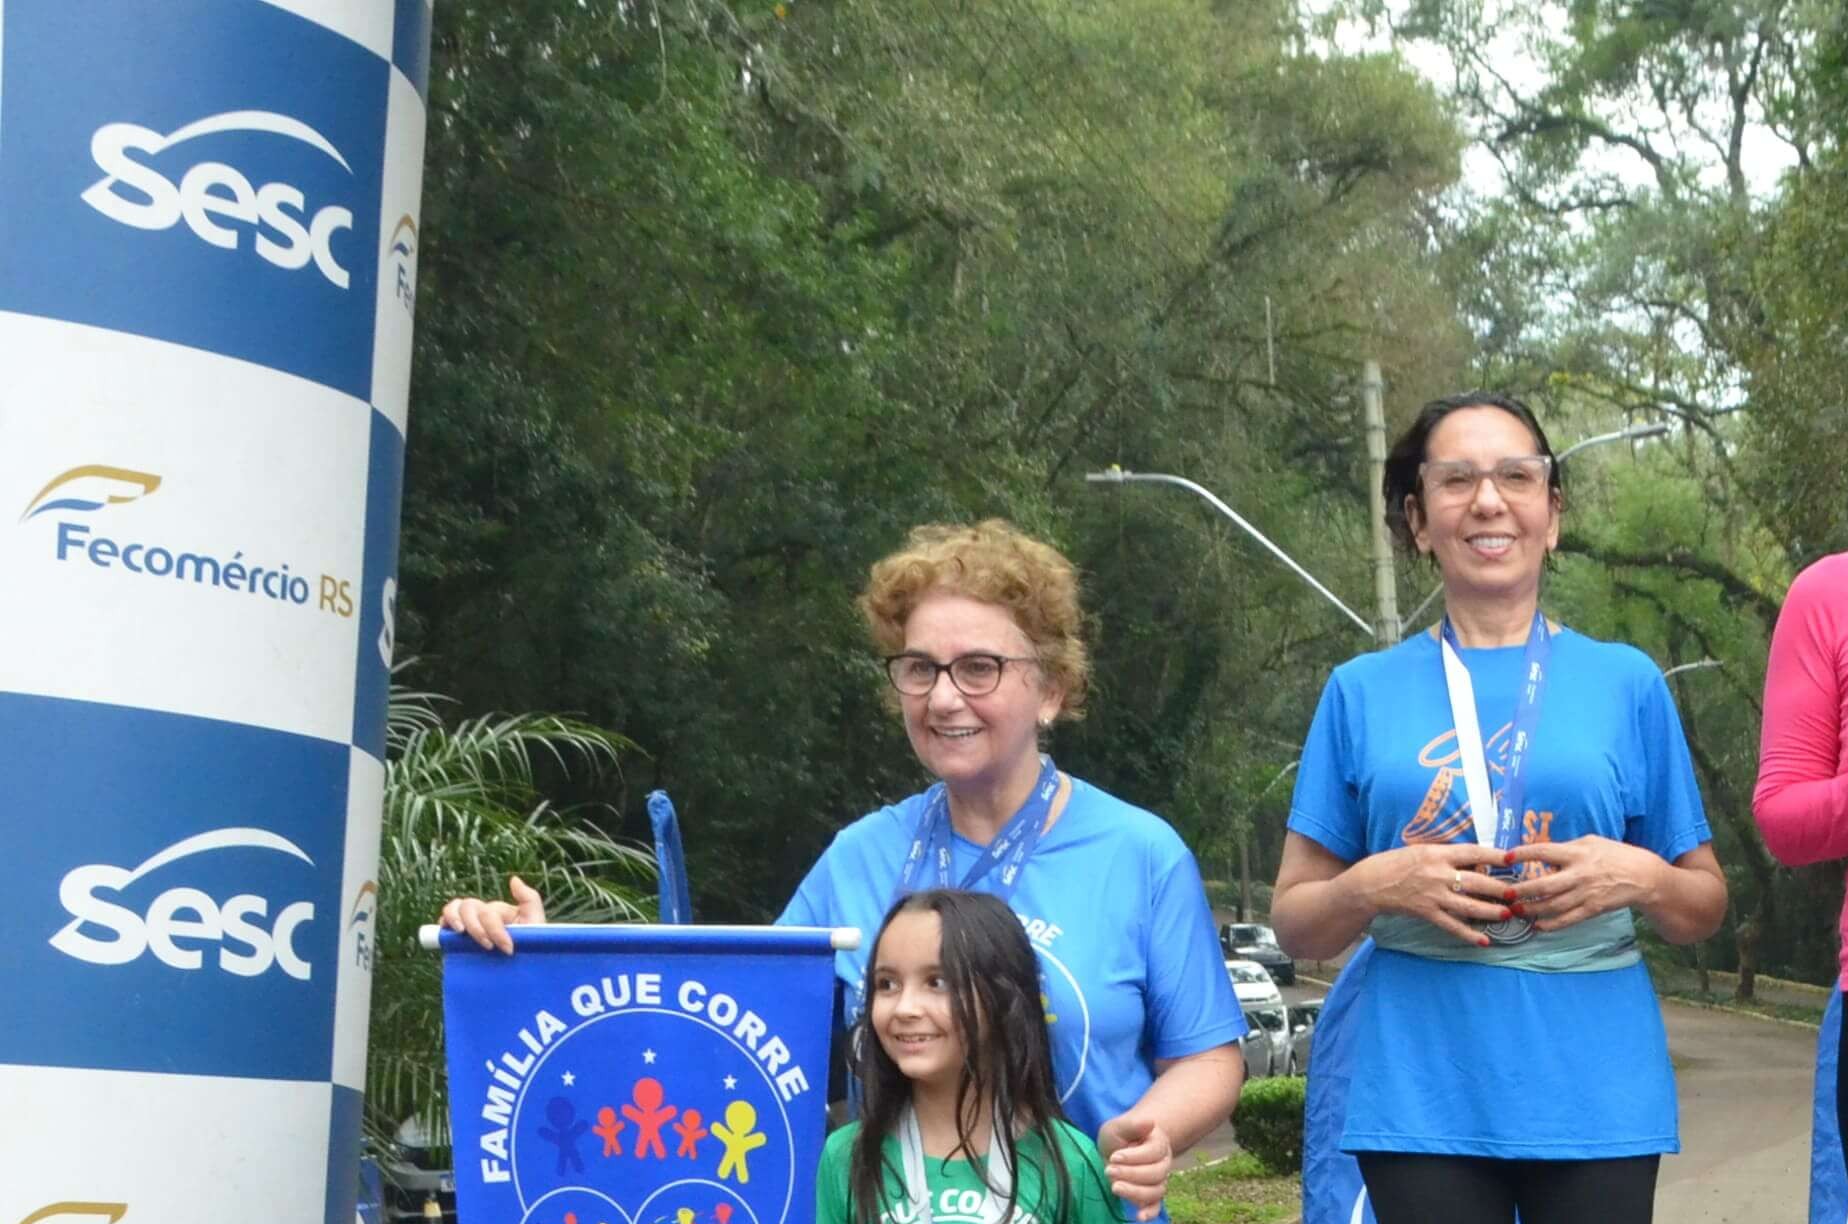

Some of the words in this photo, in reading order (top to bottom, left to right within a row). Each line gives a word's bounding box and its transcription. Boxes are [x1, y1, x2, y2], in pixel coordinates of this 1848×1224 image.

[80, 121, 353, 289] Sesc
[57, 522, 310, 605] Fecomércio
[320, 574, 354, 618] RS
[49, 864, 315, 981] Sesc
[480, 1009, 567, 1184] FAMÍLIA
[570, 973, 662, 1018] QUE
[678, 980, 809, 1103] CORRE
